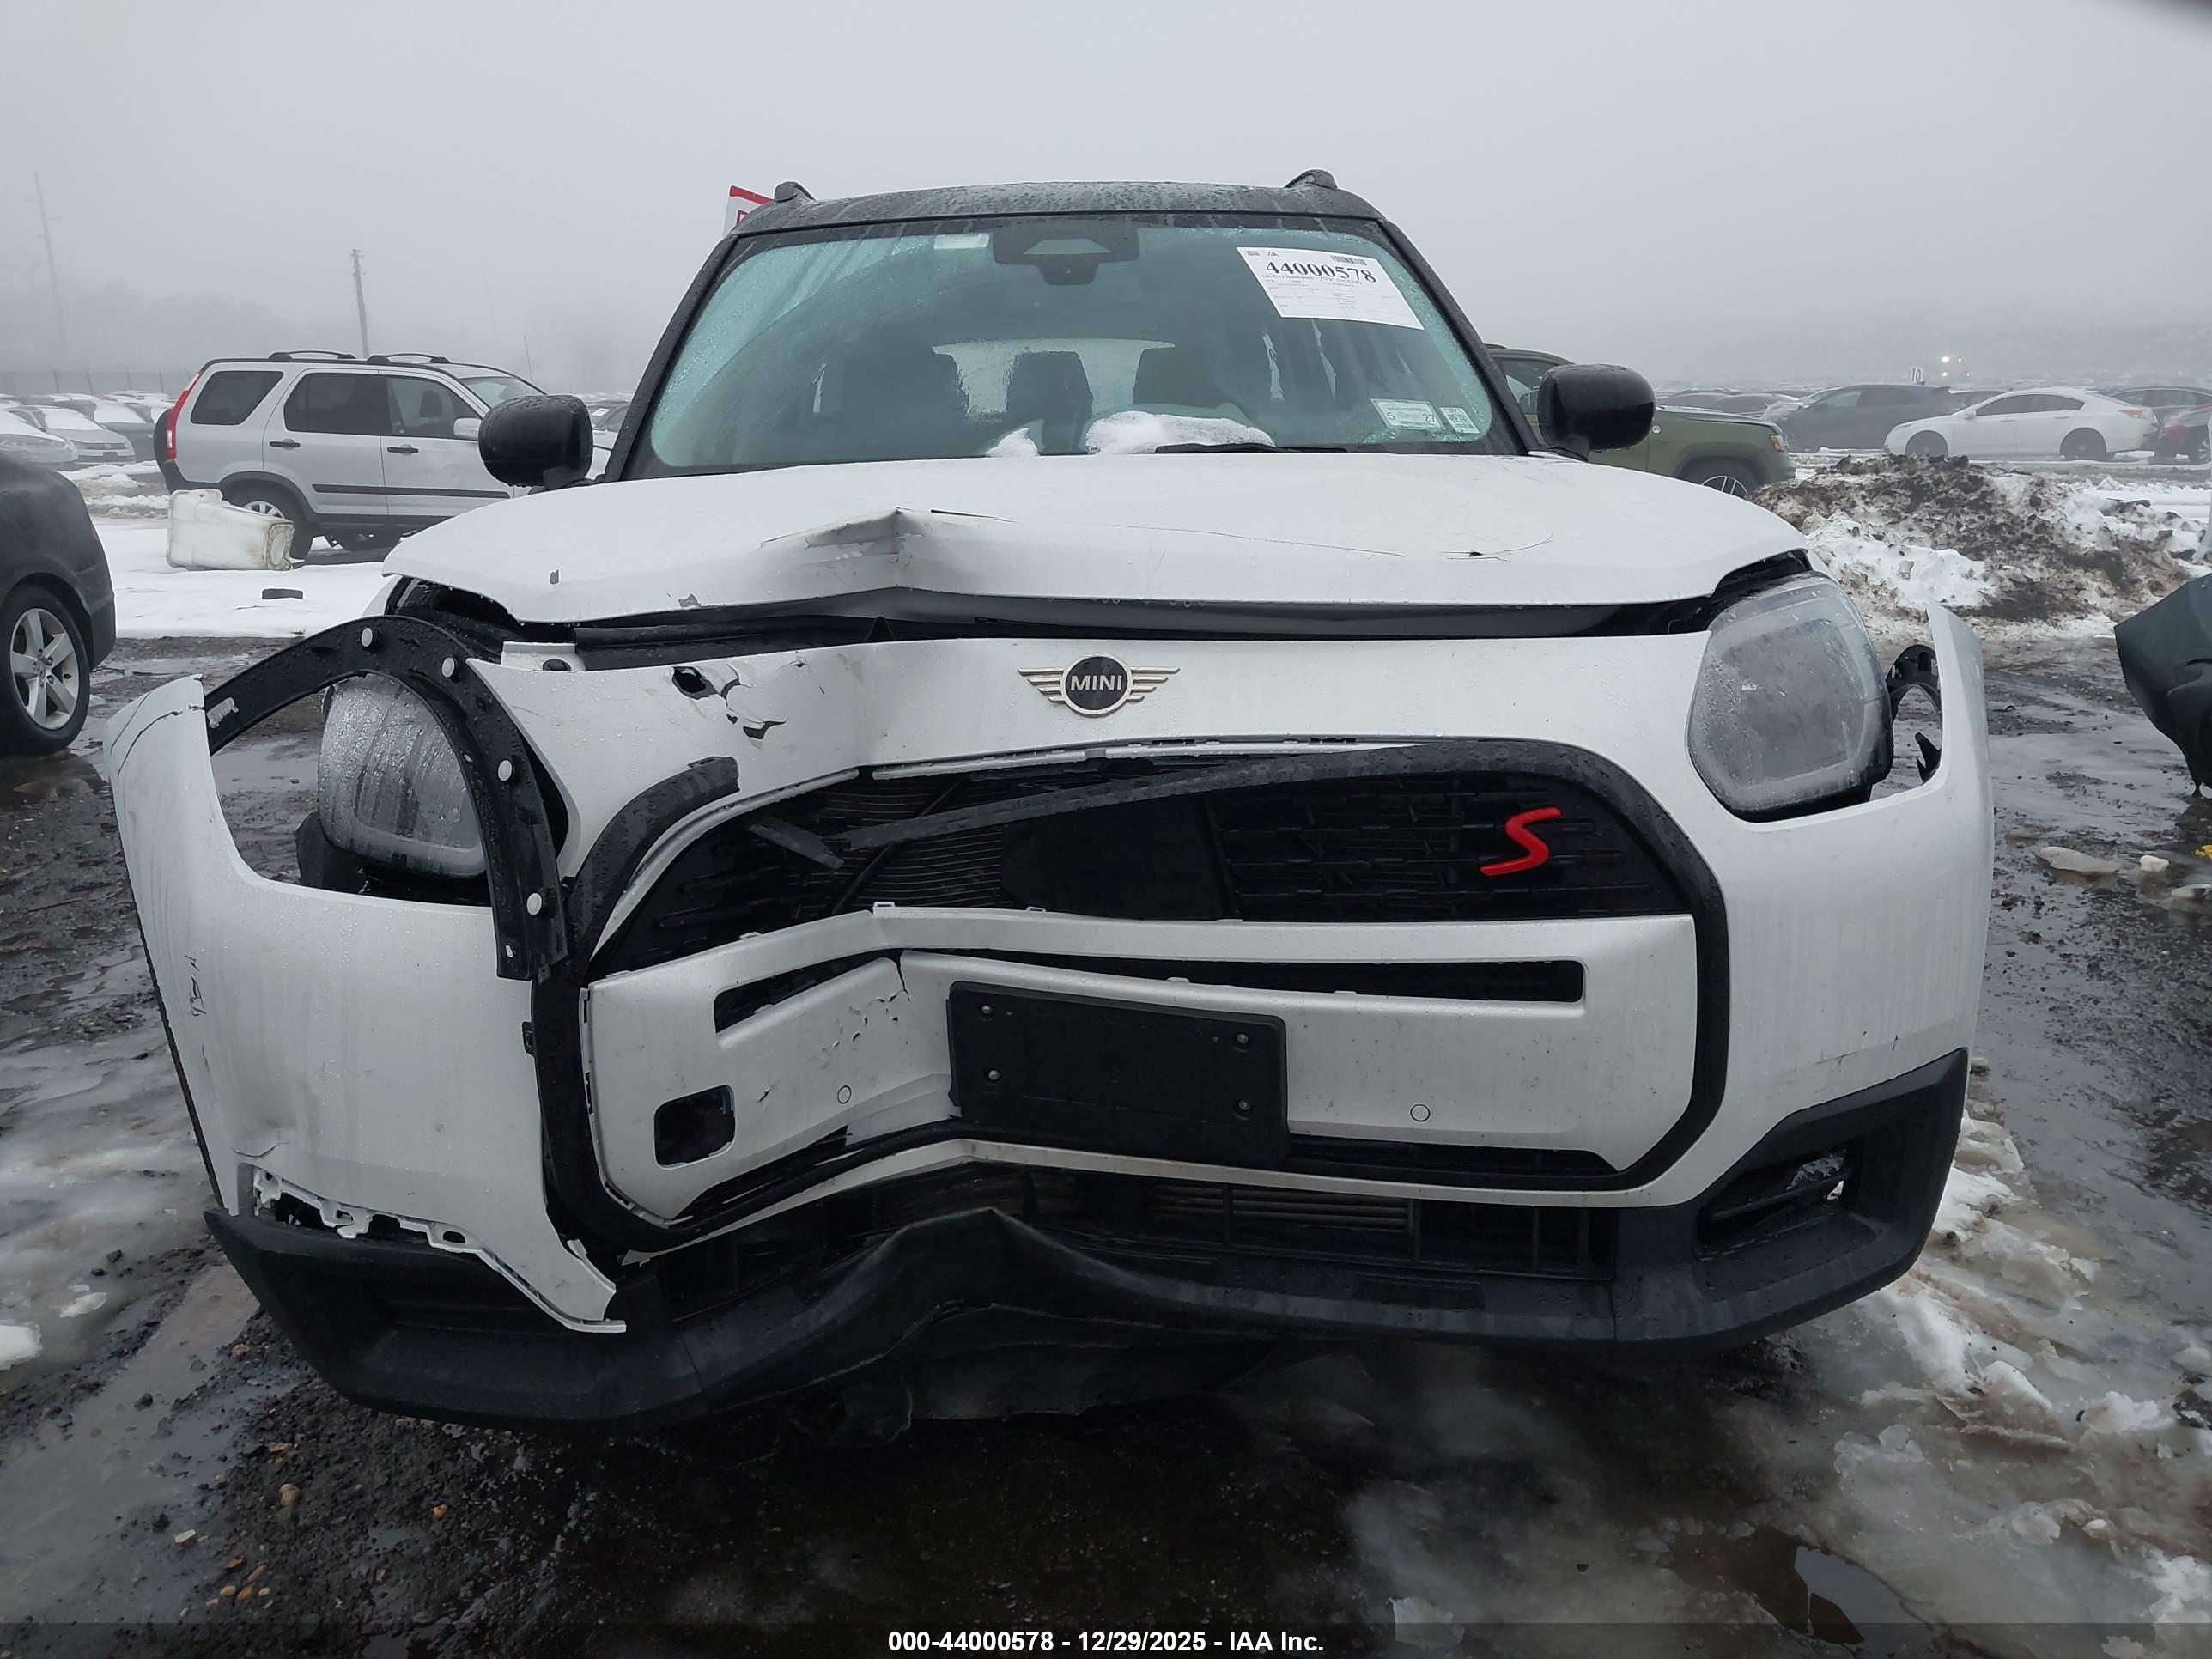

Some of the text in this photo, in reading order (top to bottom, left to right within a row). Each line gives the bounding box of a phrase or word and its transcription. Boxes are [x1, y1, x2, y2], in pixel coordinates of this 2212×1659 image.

[1267, 261, 1377, 283] 44000578
[1911, 368, 1922, 382] 10
[1070, 674, 1122, 691] MINI
[1480, 806, 1562, 876] S
